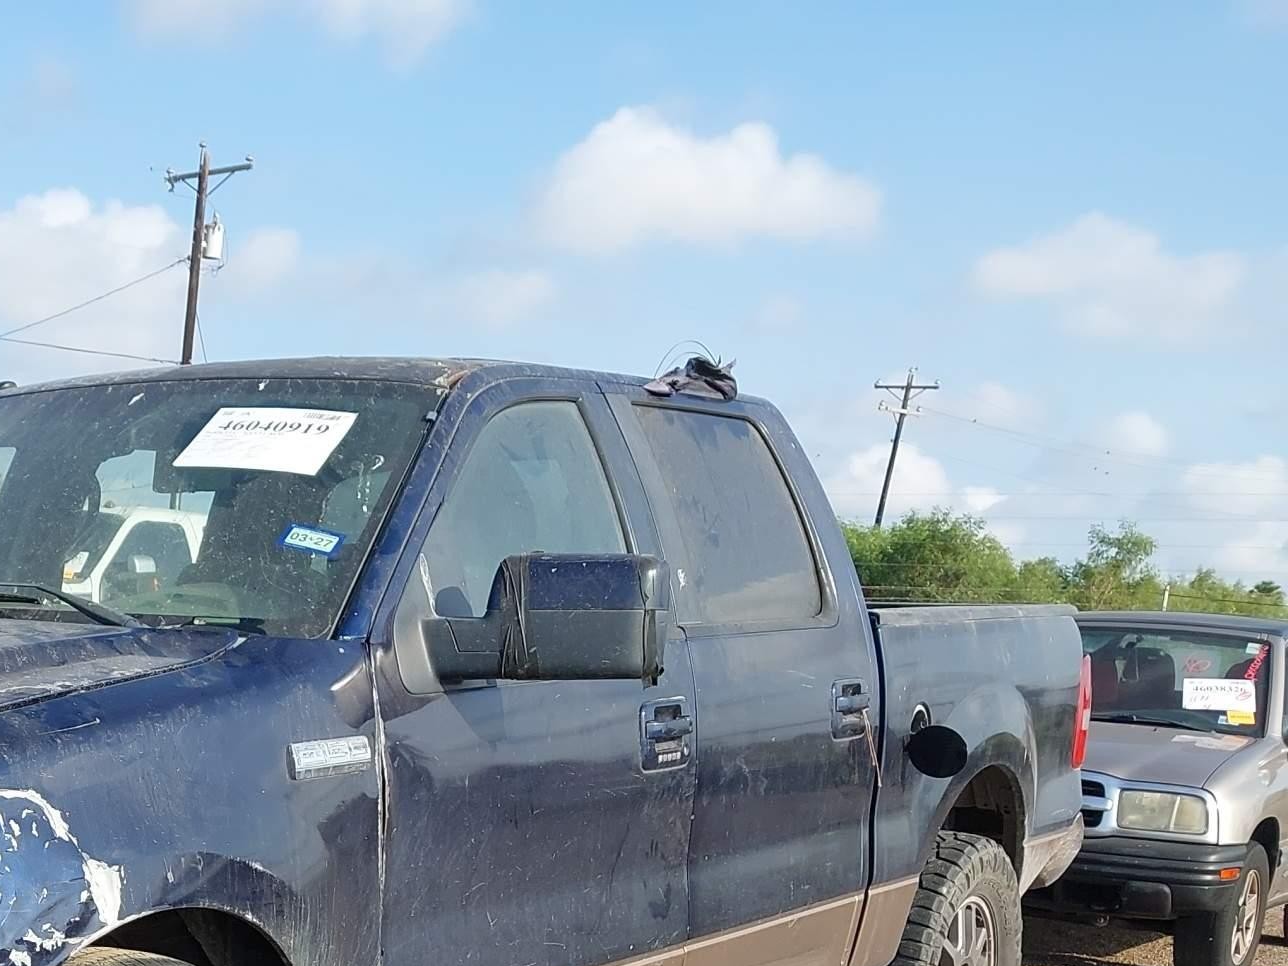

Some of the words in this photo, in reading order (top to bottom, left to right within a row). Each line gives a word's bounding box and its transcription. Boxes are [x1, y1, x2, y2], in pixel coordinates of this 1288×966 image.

[218, 418, 330, 435] 46040919
[290, 531, 309, 542] 03
[313, 536, 334, 547] 27
